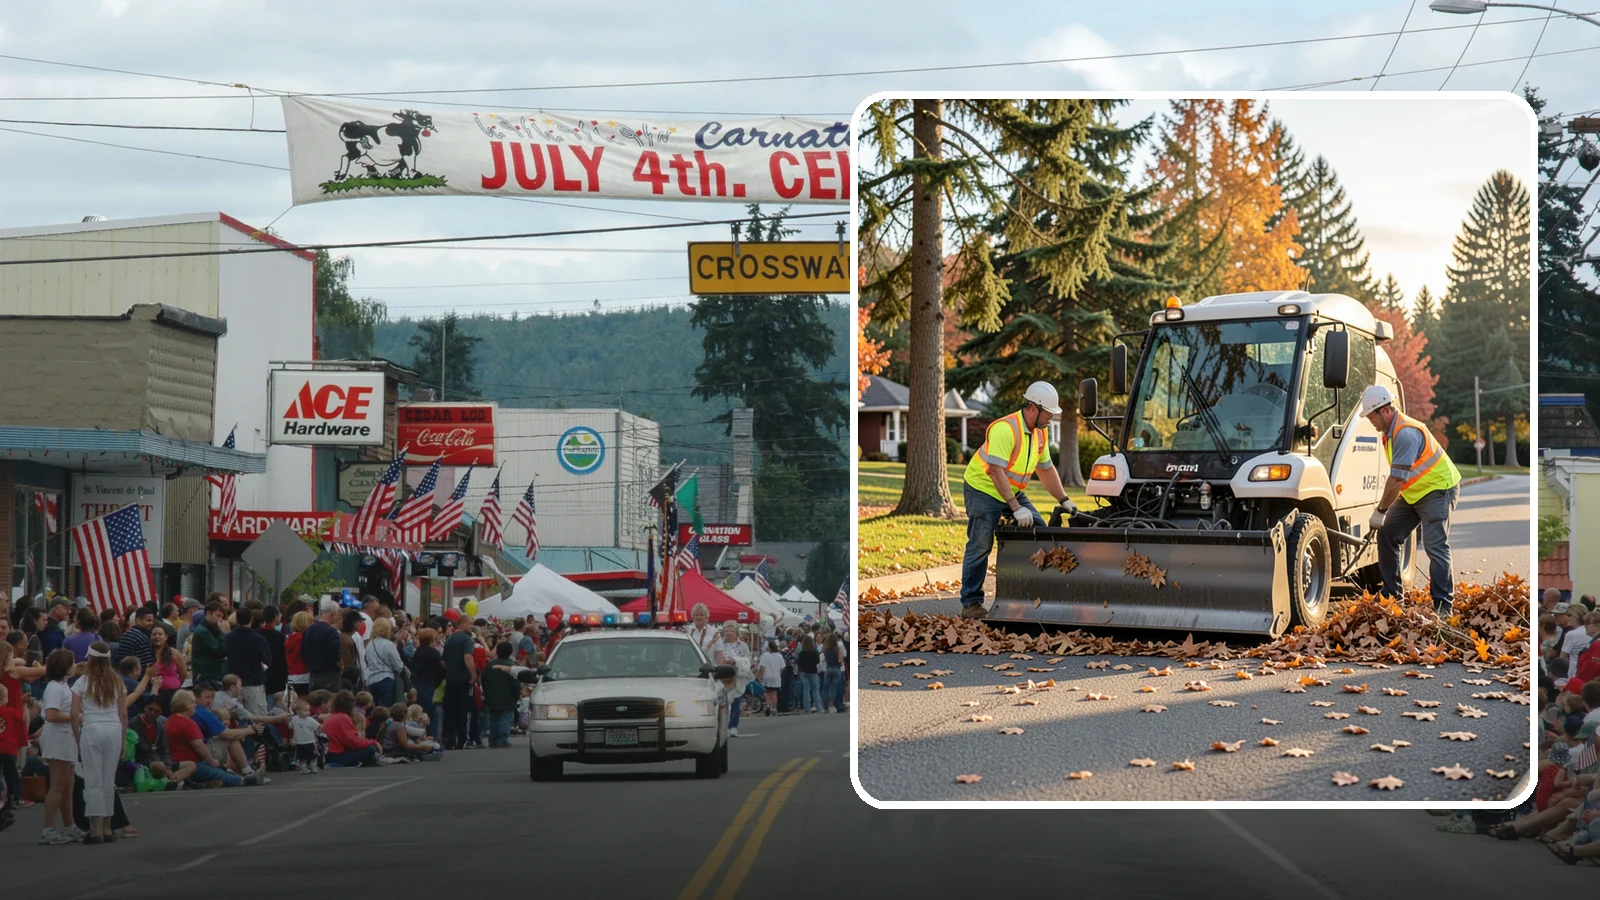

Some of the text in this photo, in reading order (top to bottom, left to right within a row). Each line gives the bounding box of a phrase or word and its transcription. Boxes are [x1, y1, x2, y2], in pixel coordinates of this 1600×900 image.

[481, 141, 604, 192] JULY
[632, 150, 746, 197] 4th.
[696, 254, 850, 280] CROSSWA
[283, 380, 373, 420] ACE
[405, 409, 452, 421] CEDAR
[283, 421, 370, 436] Hardware
[353, 466, 385, 479] Simpl
[83, 485, 155, 495] St. Vincent de Paul
[81, 503, 154, 522] THT
[212, 516, 331, 535] HARDARE
[687, 526, 741, 535] CRNATION
[699, 535, 730, 543] GLASS
